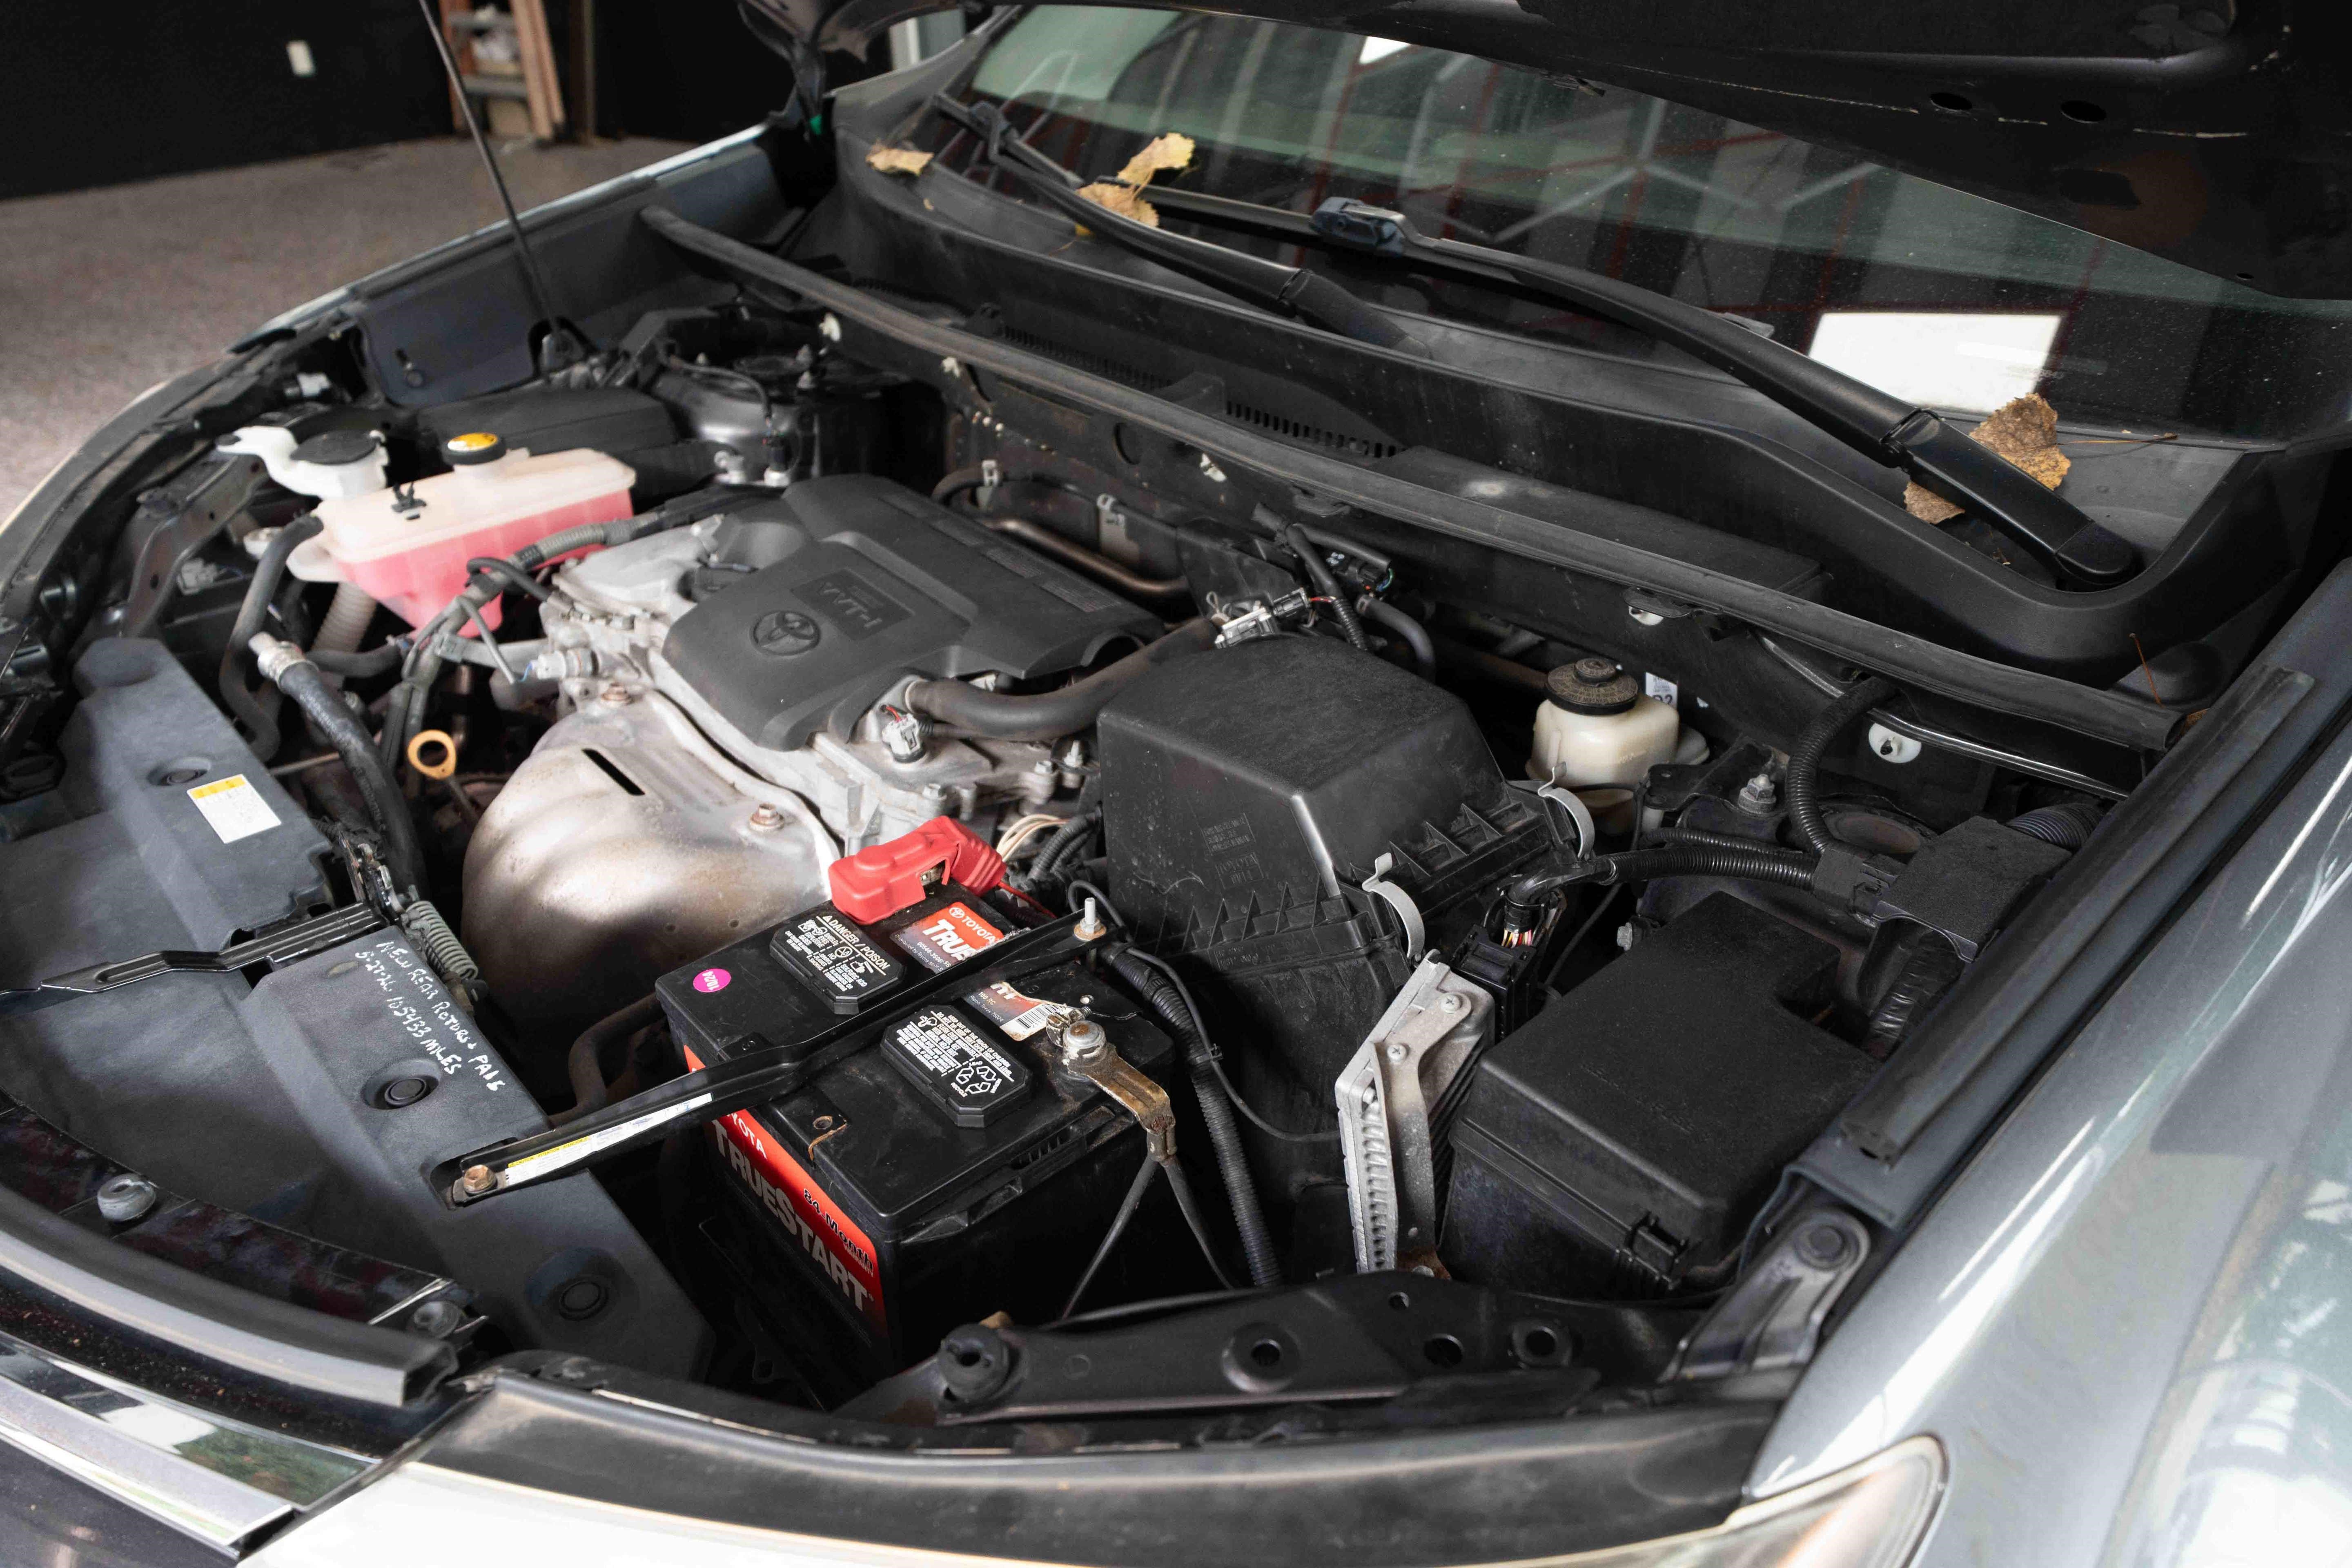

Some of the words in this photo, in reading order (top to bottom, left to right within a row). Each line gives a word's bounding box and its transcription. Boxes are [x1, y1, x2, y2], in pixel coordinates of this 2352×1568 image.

[829, 920, 859, 944] DANGER
[860, 946, 890, 970] POISON
[961, 916, 996, 944] TOYOTA
[376, 942, 411, 968] NEW
[409, 968, 439, 999] REAR
[702, 971, 720, 991] 10/24
[840, 964, 859, 980] SULFURIC
[978, 991, 989, 1000] 100
[980, 1002, 992, 1014] Texas
[991, 1009, 1004, 1022] 75024
[420, 1038, 462, 1074] MILES
[712, 1119, 867, 1311] TRUESTART
[804, 1188, 873, 1271] 84-Month
